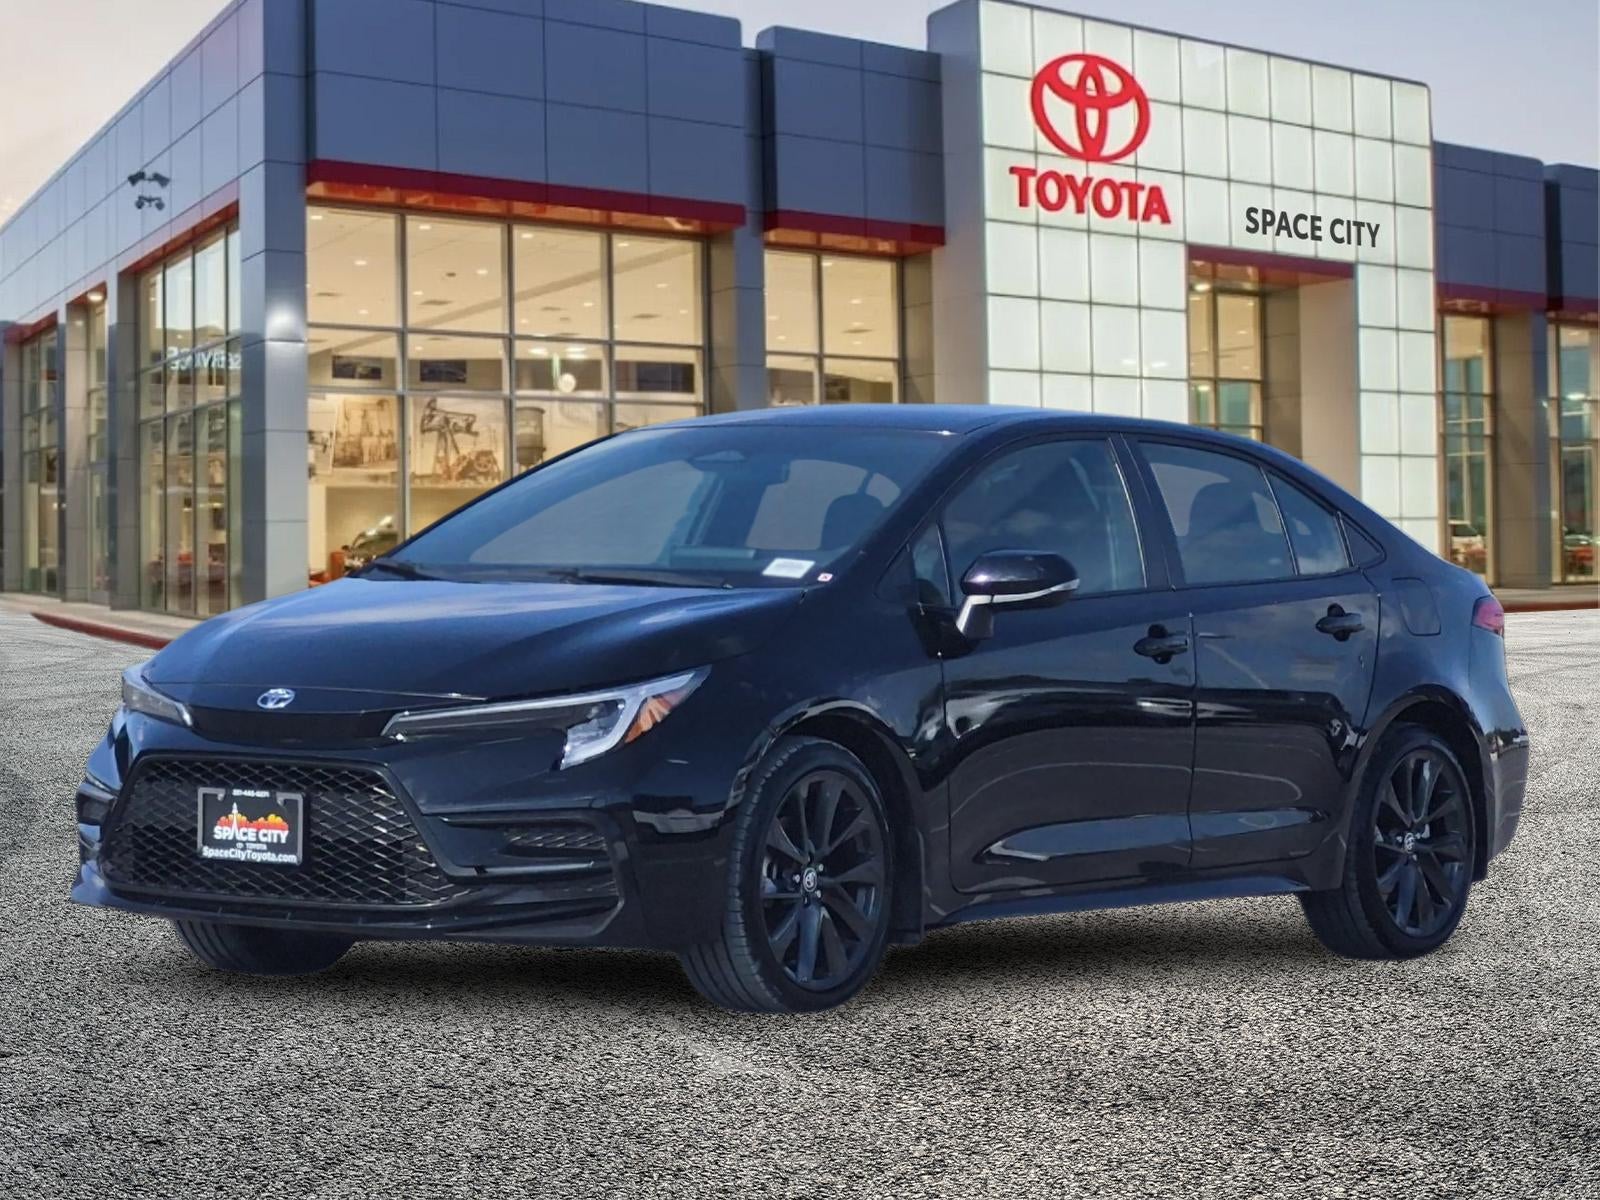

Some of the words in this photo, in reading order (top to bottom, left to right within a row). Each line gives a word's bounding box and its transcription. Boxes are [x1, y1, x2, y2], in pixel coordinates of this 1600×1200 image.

[1009, 166, 1171, 224] TOYOTA
[1245, 207, 1323, 242] SPACE
[1329, 218, 1381, 248] CITY
[213, 825, 257, 841] SPACE
[258, 829, 289, 844] CITY
[202, 845, 298, 864] SpaceCityToyota.com
